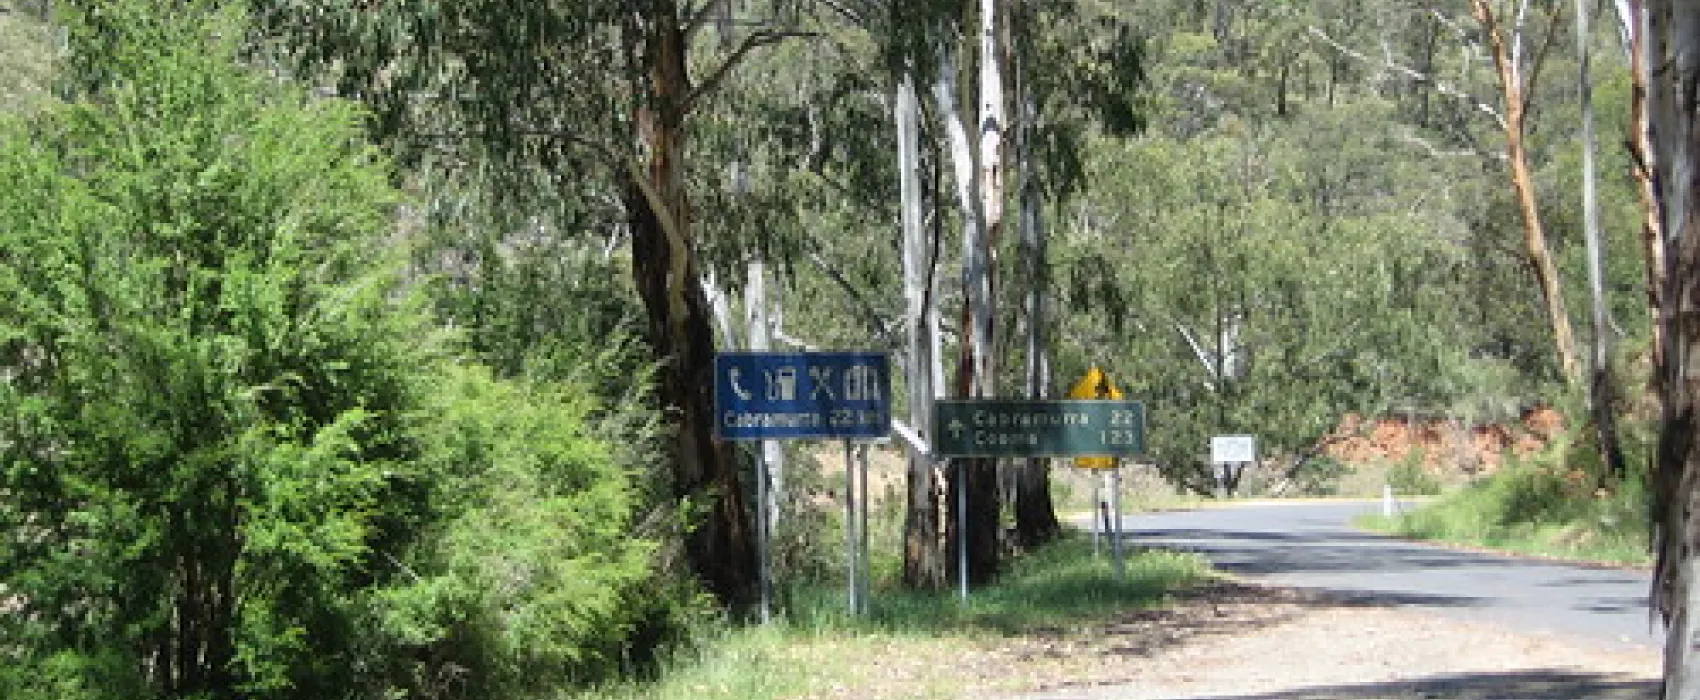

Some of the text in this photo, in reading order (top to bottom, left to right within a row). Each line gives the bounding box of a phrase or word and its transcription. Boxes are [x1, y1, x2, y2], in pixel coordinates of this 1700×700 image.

[972, 409, 1134, 426] Cabramurra 22
[1099, 429, 1134, 445] 123
